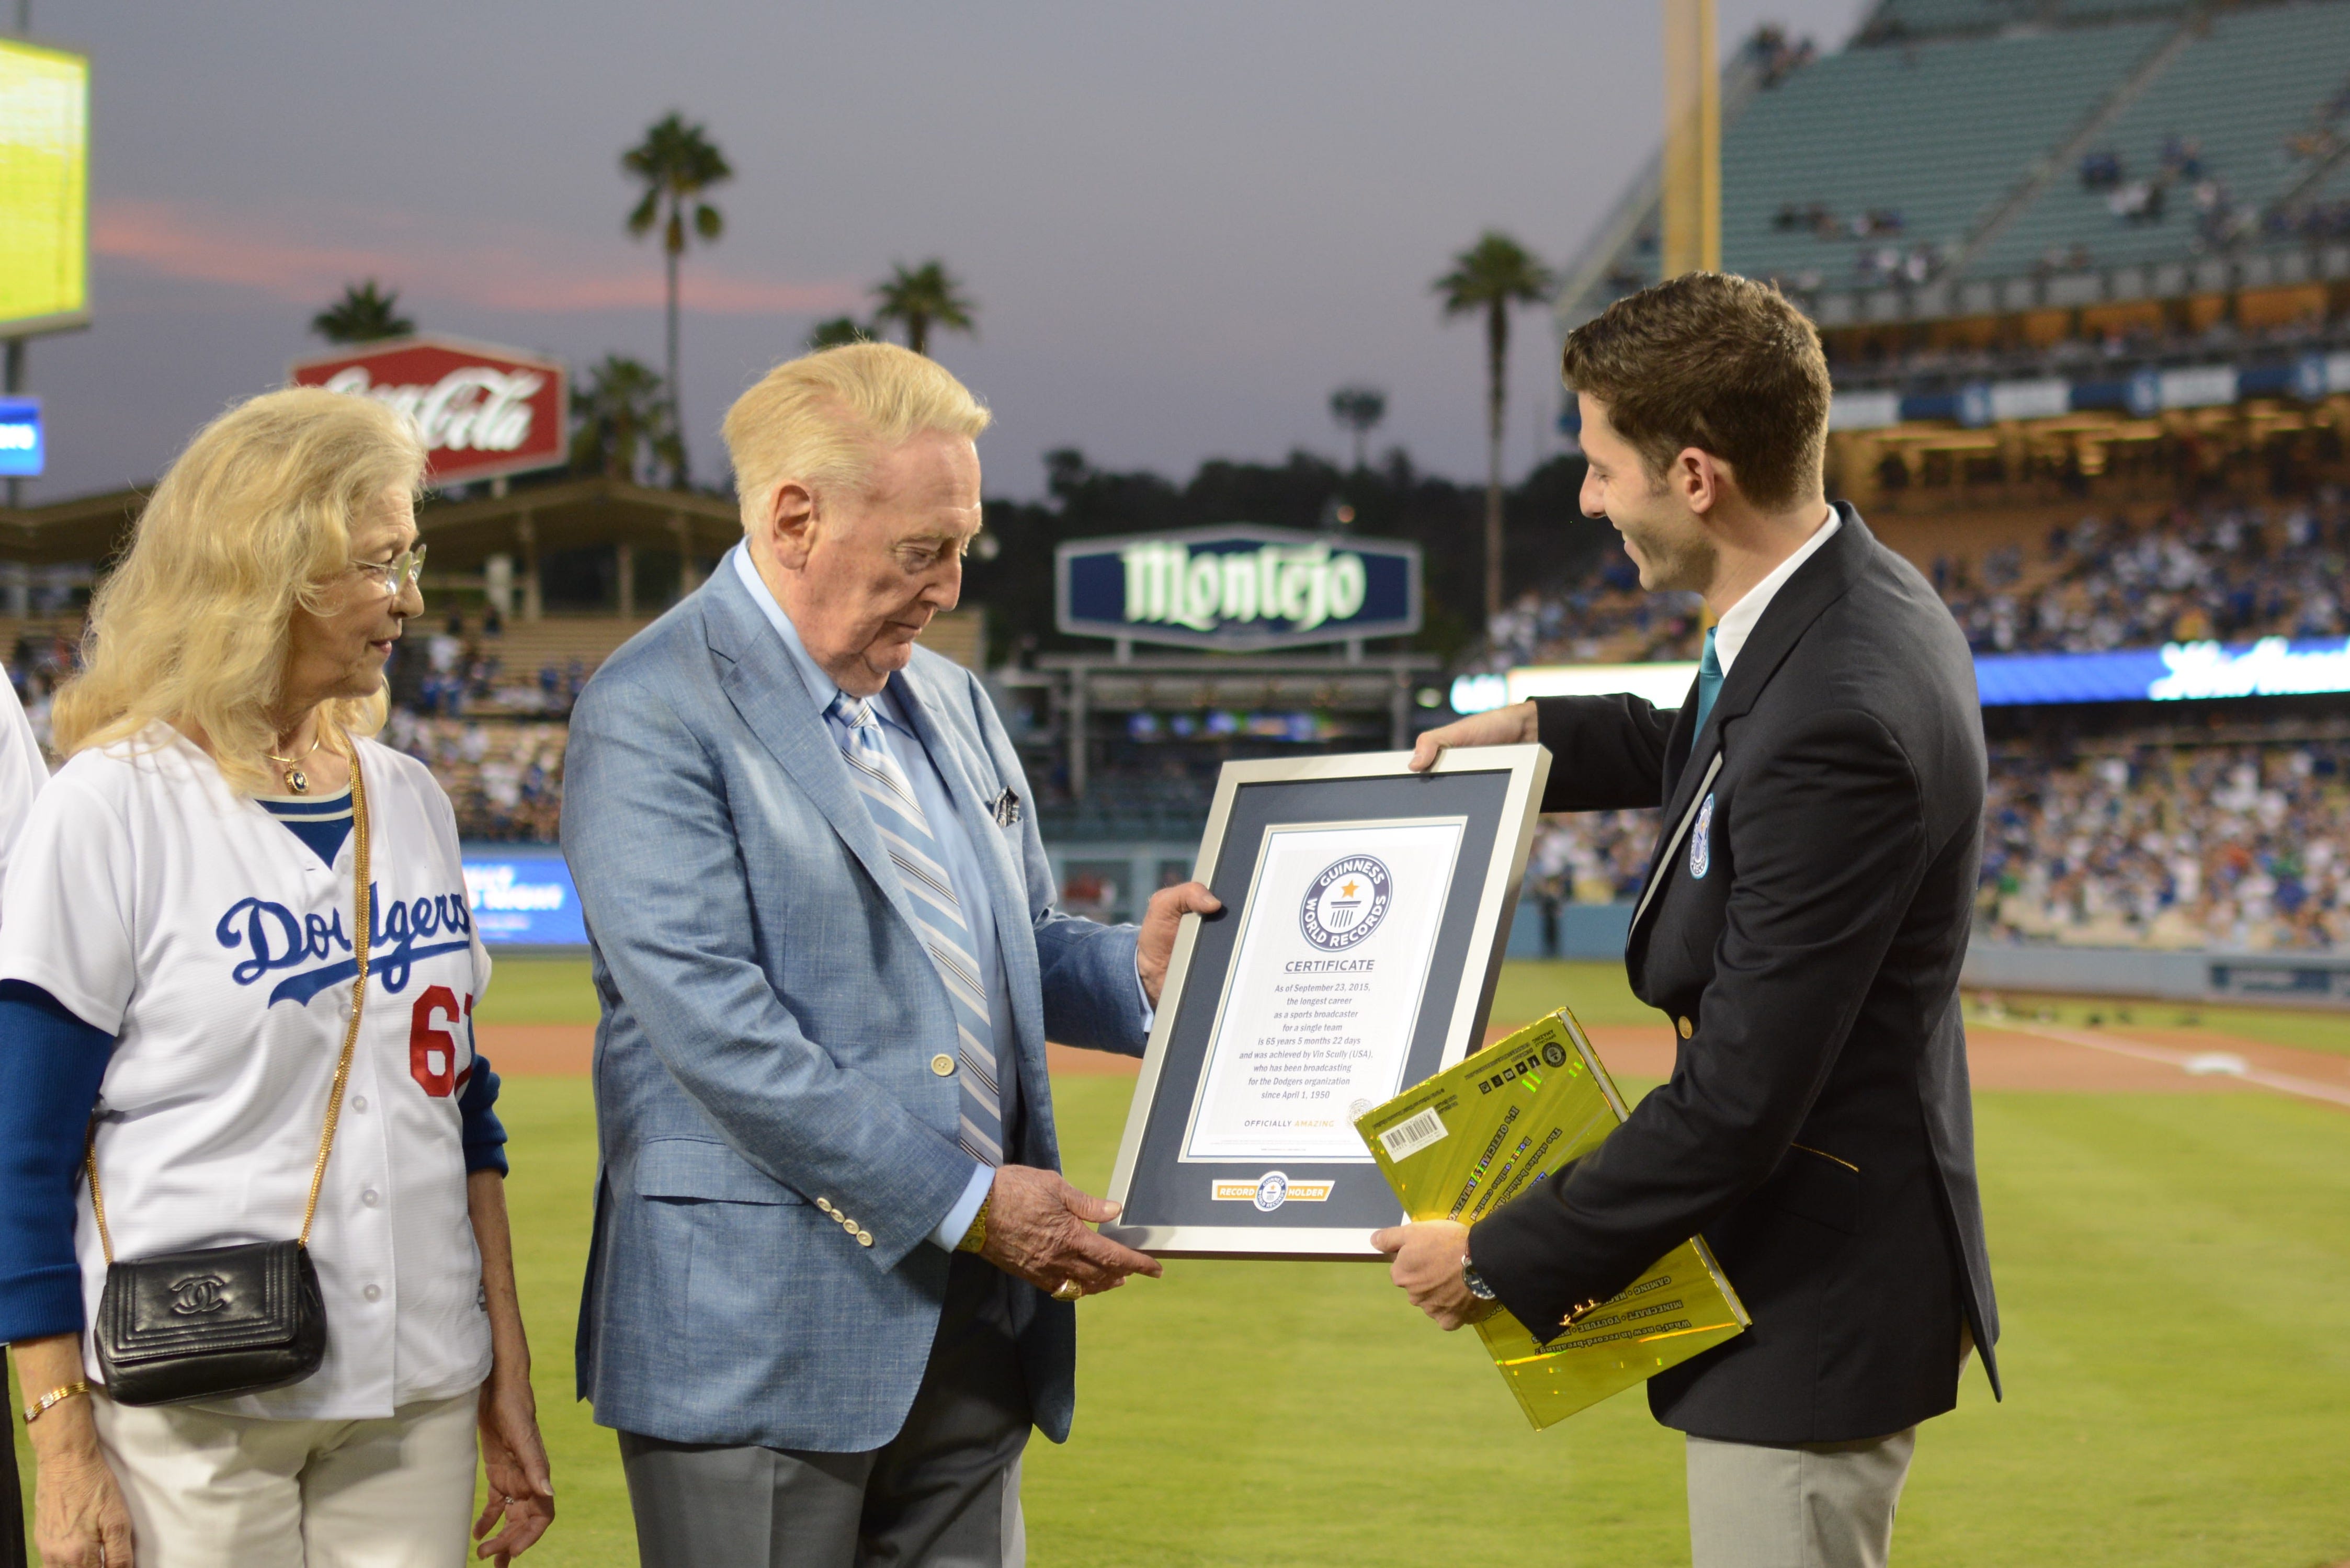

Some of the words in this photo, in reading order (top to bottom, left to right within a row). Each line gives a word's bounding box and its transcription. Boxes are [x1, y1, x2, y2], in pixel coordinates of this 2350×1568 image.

[1120, 542, 1366, 631] Montejo
[1320, 860, 1384, 887] GUINNESS
[1304, 898, 1327, 944] WORLD
[1330, 895, 1386, 947] RECORDS
[1285, 959, 1375, 972] CERTIFICATE
[1285, 984, 1293, 992] of
[1294, 983, 1333, 993] September
[1335, 983, 1347, 993] 23,
[1300, 997, 1327, 1006] longest
[1290, 1010, 1312, 1019] sports
[1314, 1010, 1358, 1018] broadcaster
[1300, 1024, 1322, 1032] single
[1531, 1029, 1554, 1043] AMAZING
[1277, 1038, 1296, 1047] years
[1304, 1037, 1331, 1045] months
[1344, 1037, 1361, 1046] days
[1303, 1050, 1311, 1060] by
[1325, 1050, 1348, 1059] Scully
[1303, 1063, 1352, 1073] broadcasting
[1273, 1077, 1303, 1087] Dodgers
[1304, 1077, 1350, 1087] organization
[1282, 1090, 1300, 1100] April
[1301, 1090, 1308, 1099] 1,
[1310, 1090, 1330, 1099] 1950
[1504, 1105, 1519, 1124] It's
[1546, 1128, 1563, 1144] The
[1474, 1124, 1508, 1179] OFFICIALLY
[1508, 1136, 1532, 1164] Bonus
[1525, 1142, 1548, 1171] stories
[1263, 1177, 1285, 1187] GUINNESS
[1492, 1163, 1512, 1189] online
[1502, 1168, 1529, 1199] behind
[1220, 1188, 1255, 1196] RECORD
[1288, 1188, 1324, 1197] HOLDER
[1266, 1190, 1285, 1208] RECORDS
[1448, 1177, 1478, 1221] AMAZING
[1469, 1189, 1493, 1221] content
[1633, 1276, 1672, 1295] GAMING
[1627, 1300, 1684, 1321] MINECRAFT
[1577, 1315, 1621, 1333] YOUTUBE
[1633, 1325, 1655, 1334] new
[1656, 1320, 1691, 1333] What's
[1535, 1334, 1620, 1355] record-breaking?
